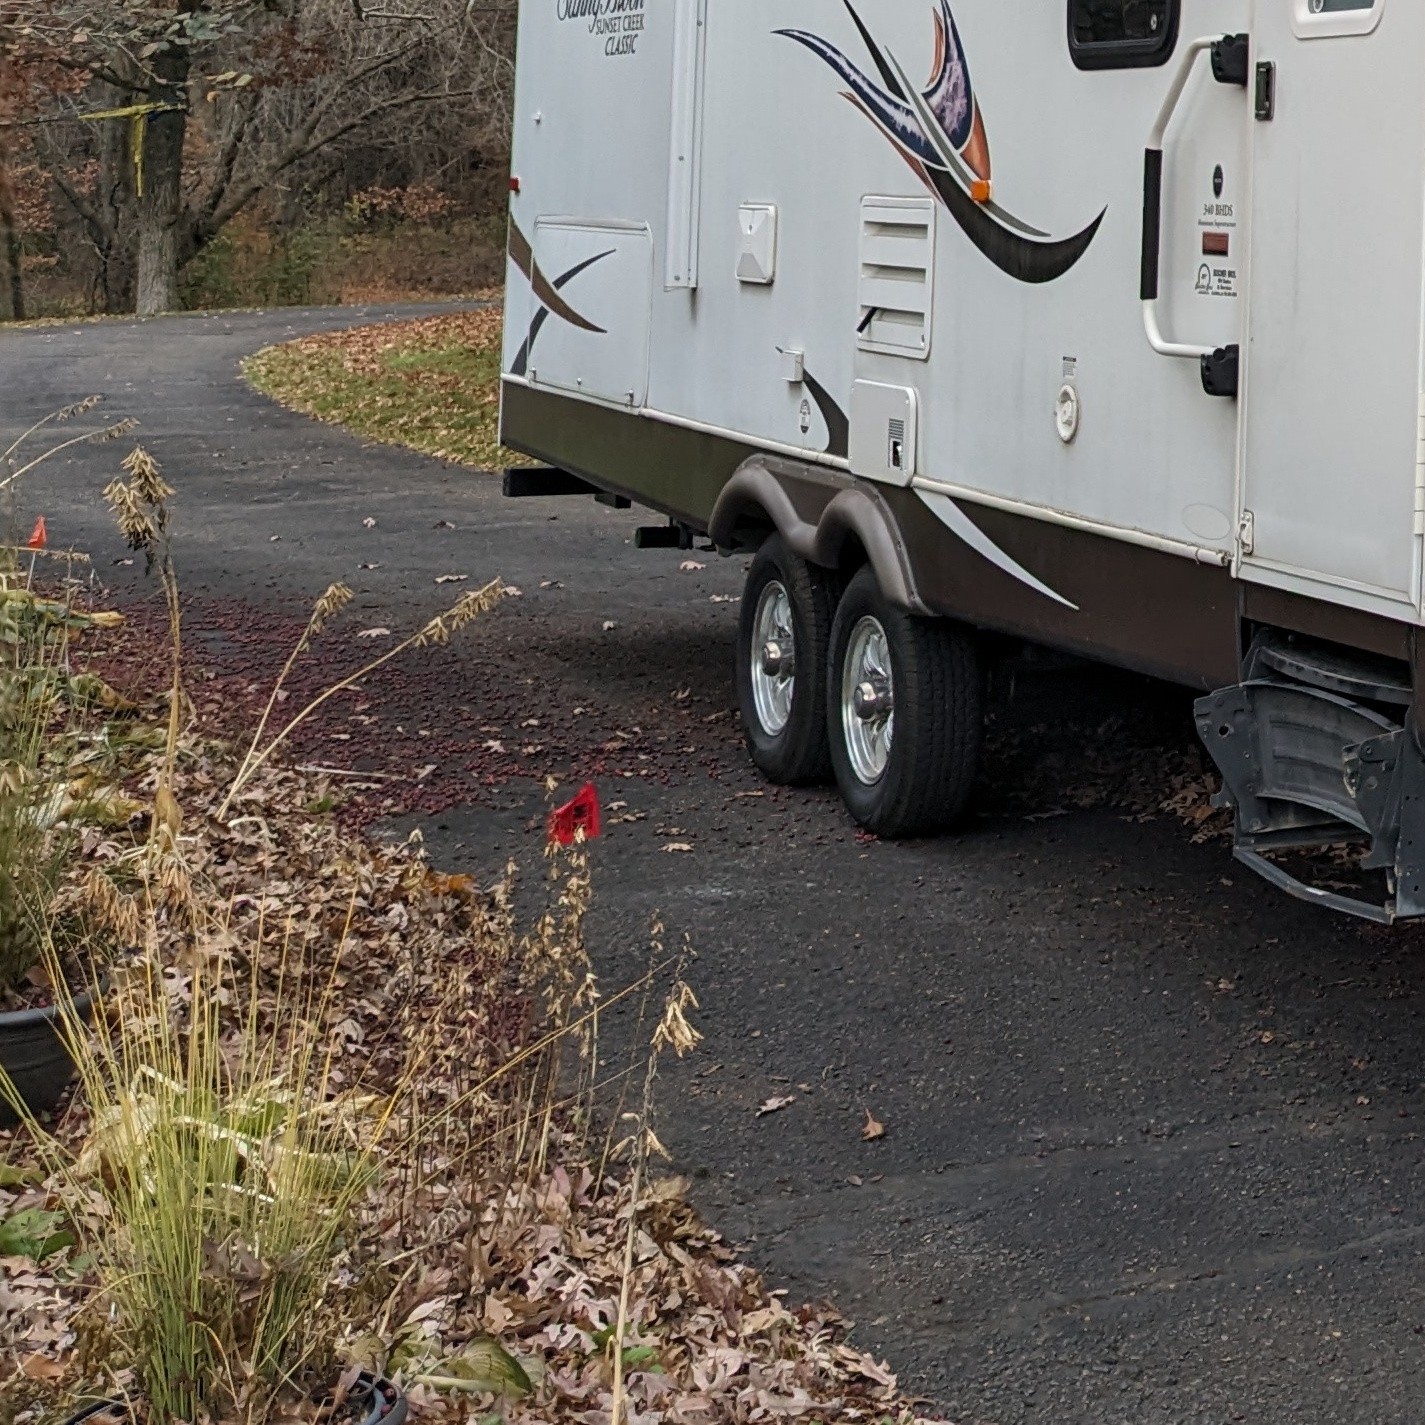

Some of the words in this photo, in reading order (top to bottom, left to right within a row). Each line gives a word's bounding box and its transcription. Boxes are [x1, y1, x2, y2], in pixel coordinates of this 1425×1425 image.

[596, 16, 622, 35] SUNSET
[622, 14, 644, 32] CREEK
[605, 34, 638, 56] CLASSIC
